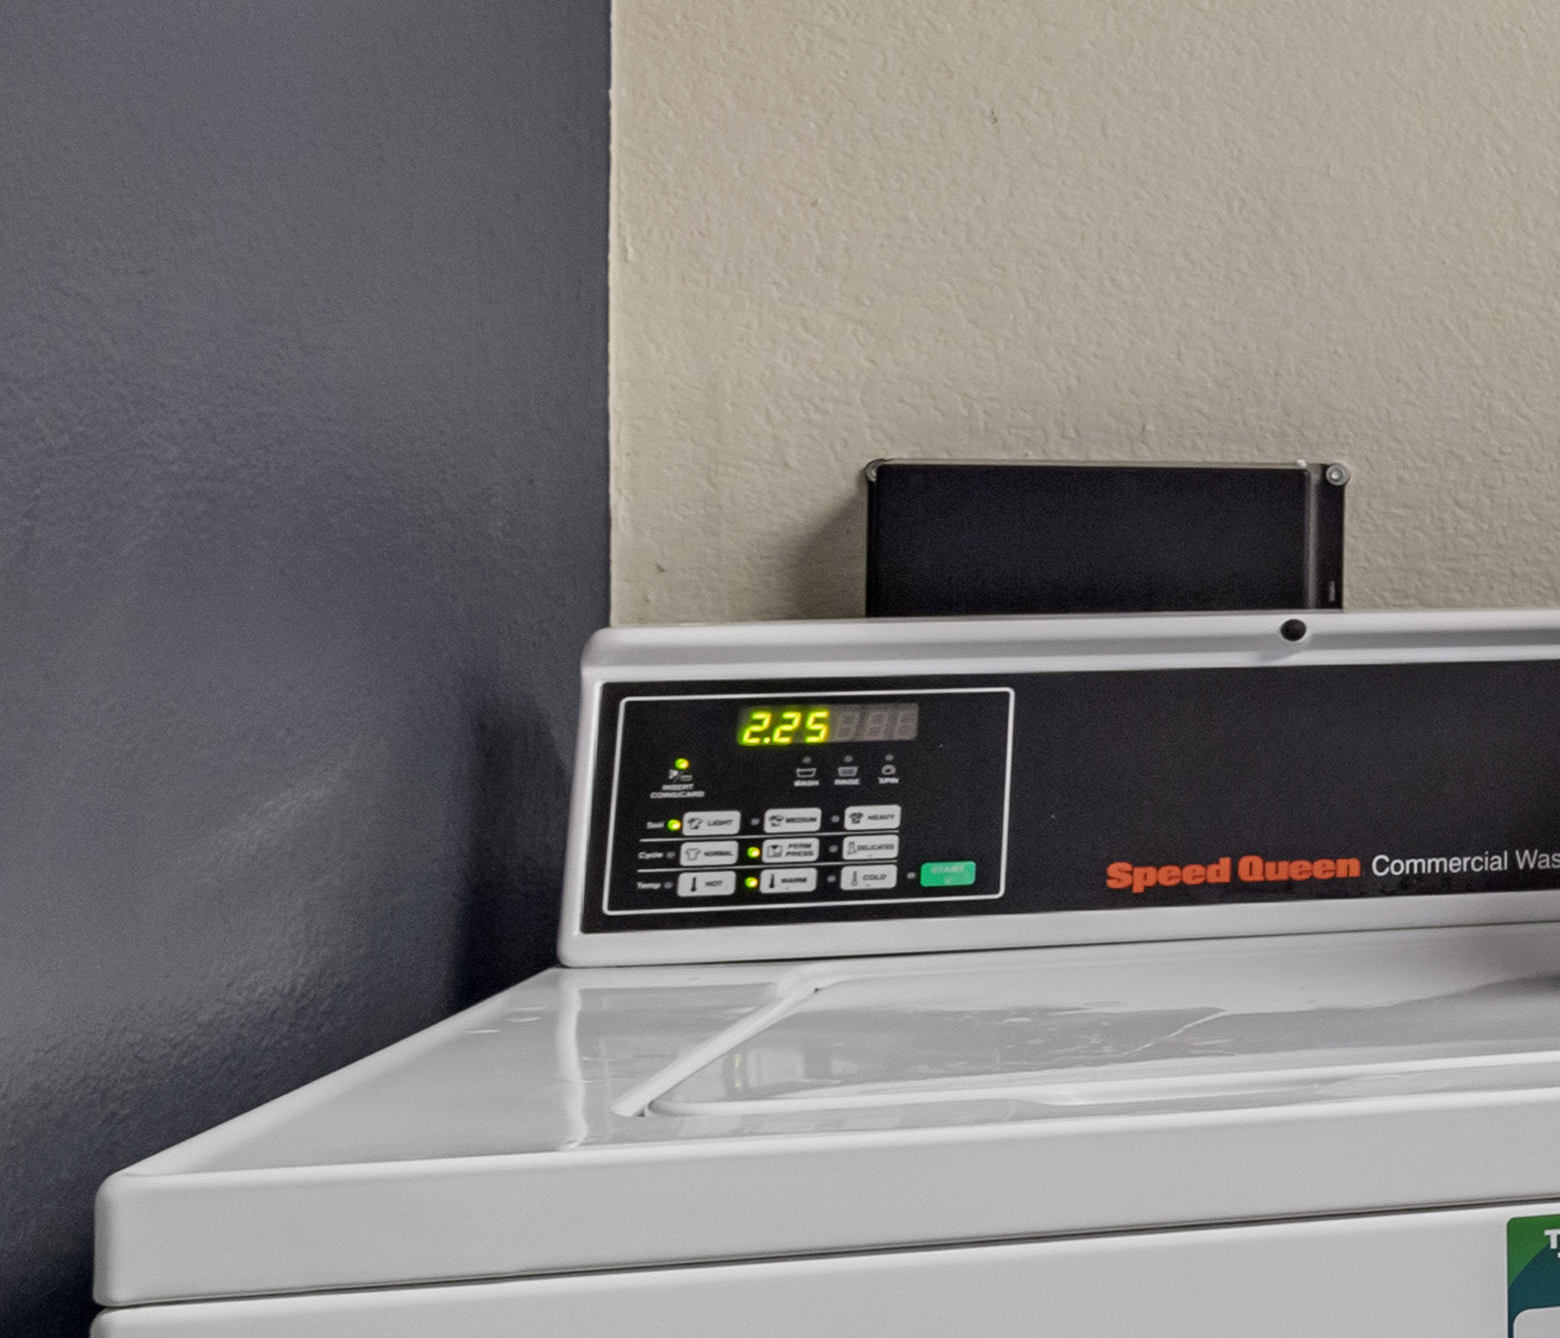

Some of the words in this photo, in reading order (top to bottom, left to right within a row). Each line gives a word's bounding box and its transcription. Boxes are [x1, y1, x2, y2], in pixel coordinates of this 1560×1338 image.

[741, 708, 831, 748] 2.25
[1105, 856, 1232, 894] Speed
[1237, 855, 1362, 883] Queen
[1371, 850, 1509, 879] Commercial
